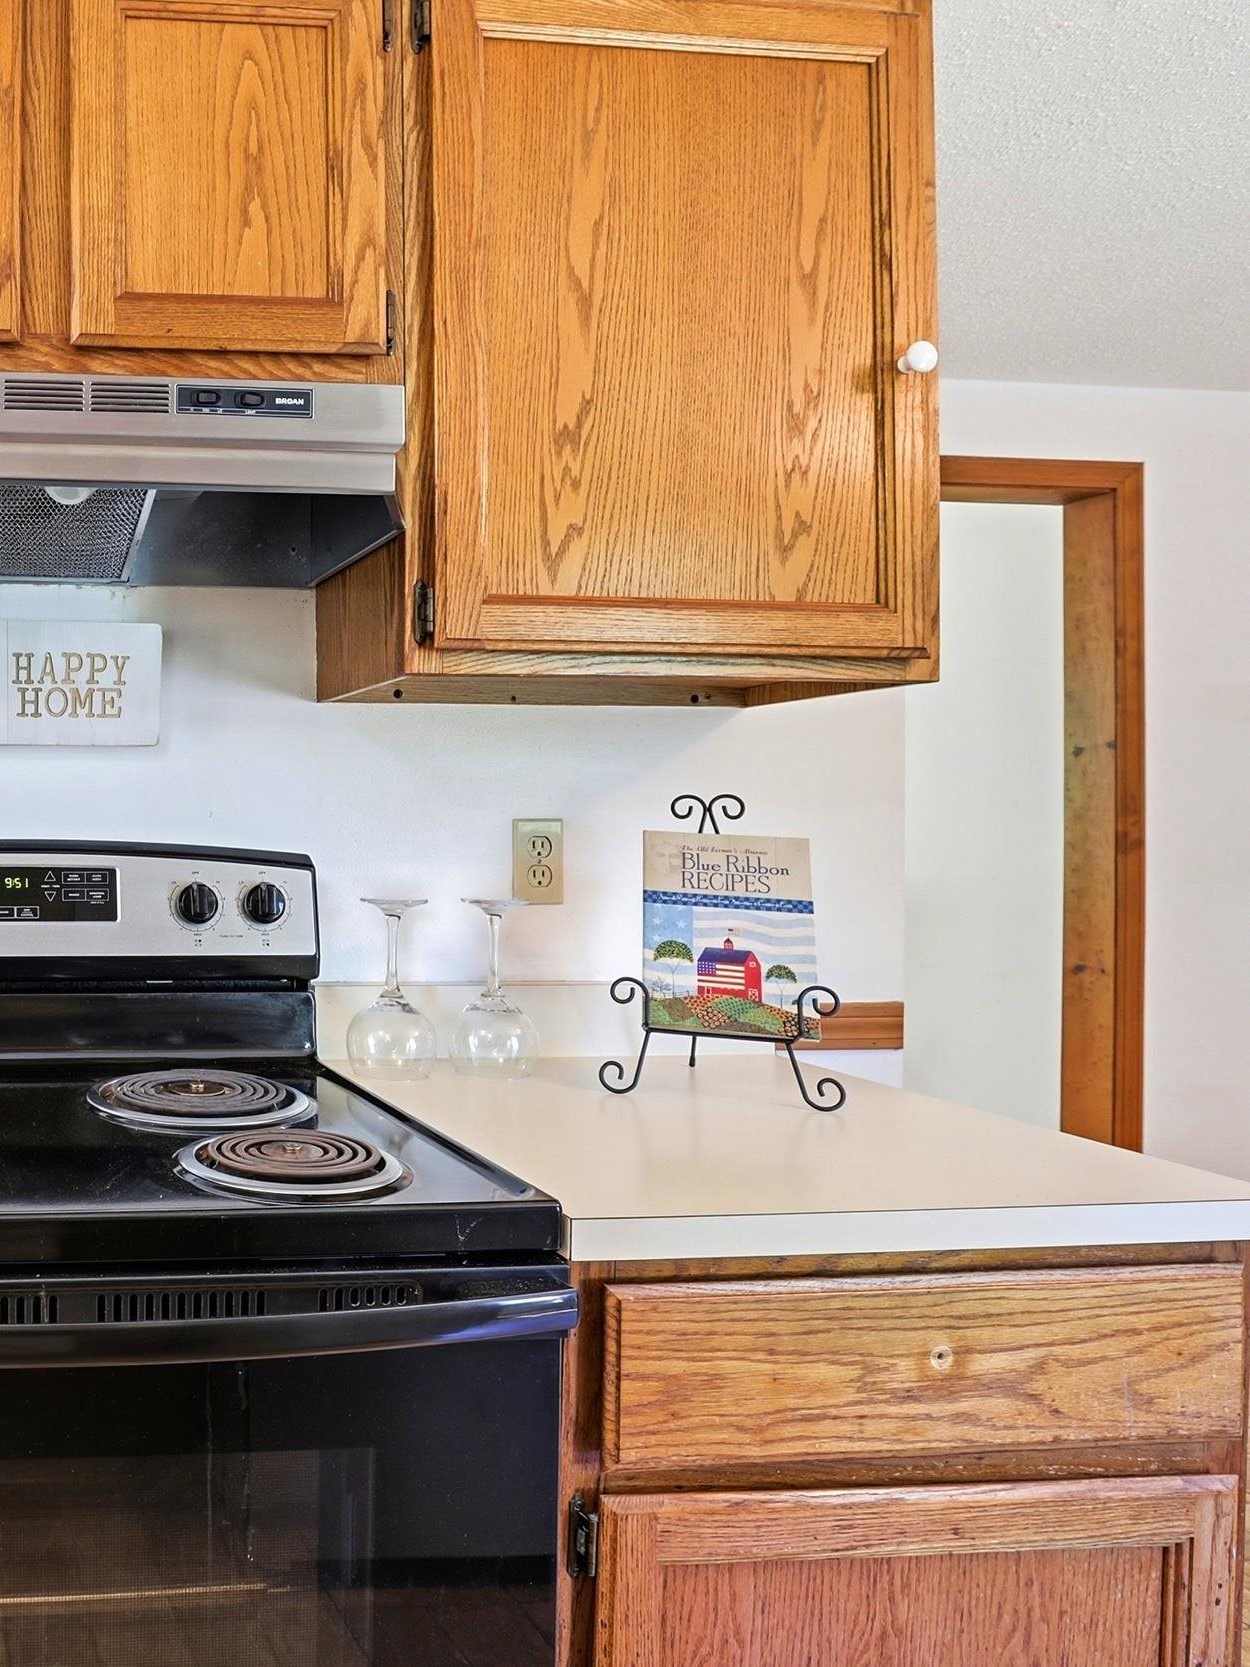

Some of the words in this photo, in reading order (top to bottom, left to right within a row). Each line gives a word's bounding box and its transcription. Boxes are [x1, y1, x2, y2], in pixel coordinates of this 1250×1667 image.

[275, 397, 304, 405] BROAN
[12, 651, 130, 685] HAPPY
[16, 686, 122, 718] HOME
[681, 852, 721, 872] Blue
[726, 854, 790, 876] Ribbon
[681, 871, 771, 894] RECIPES
